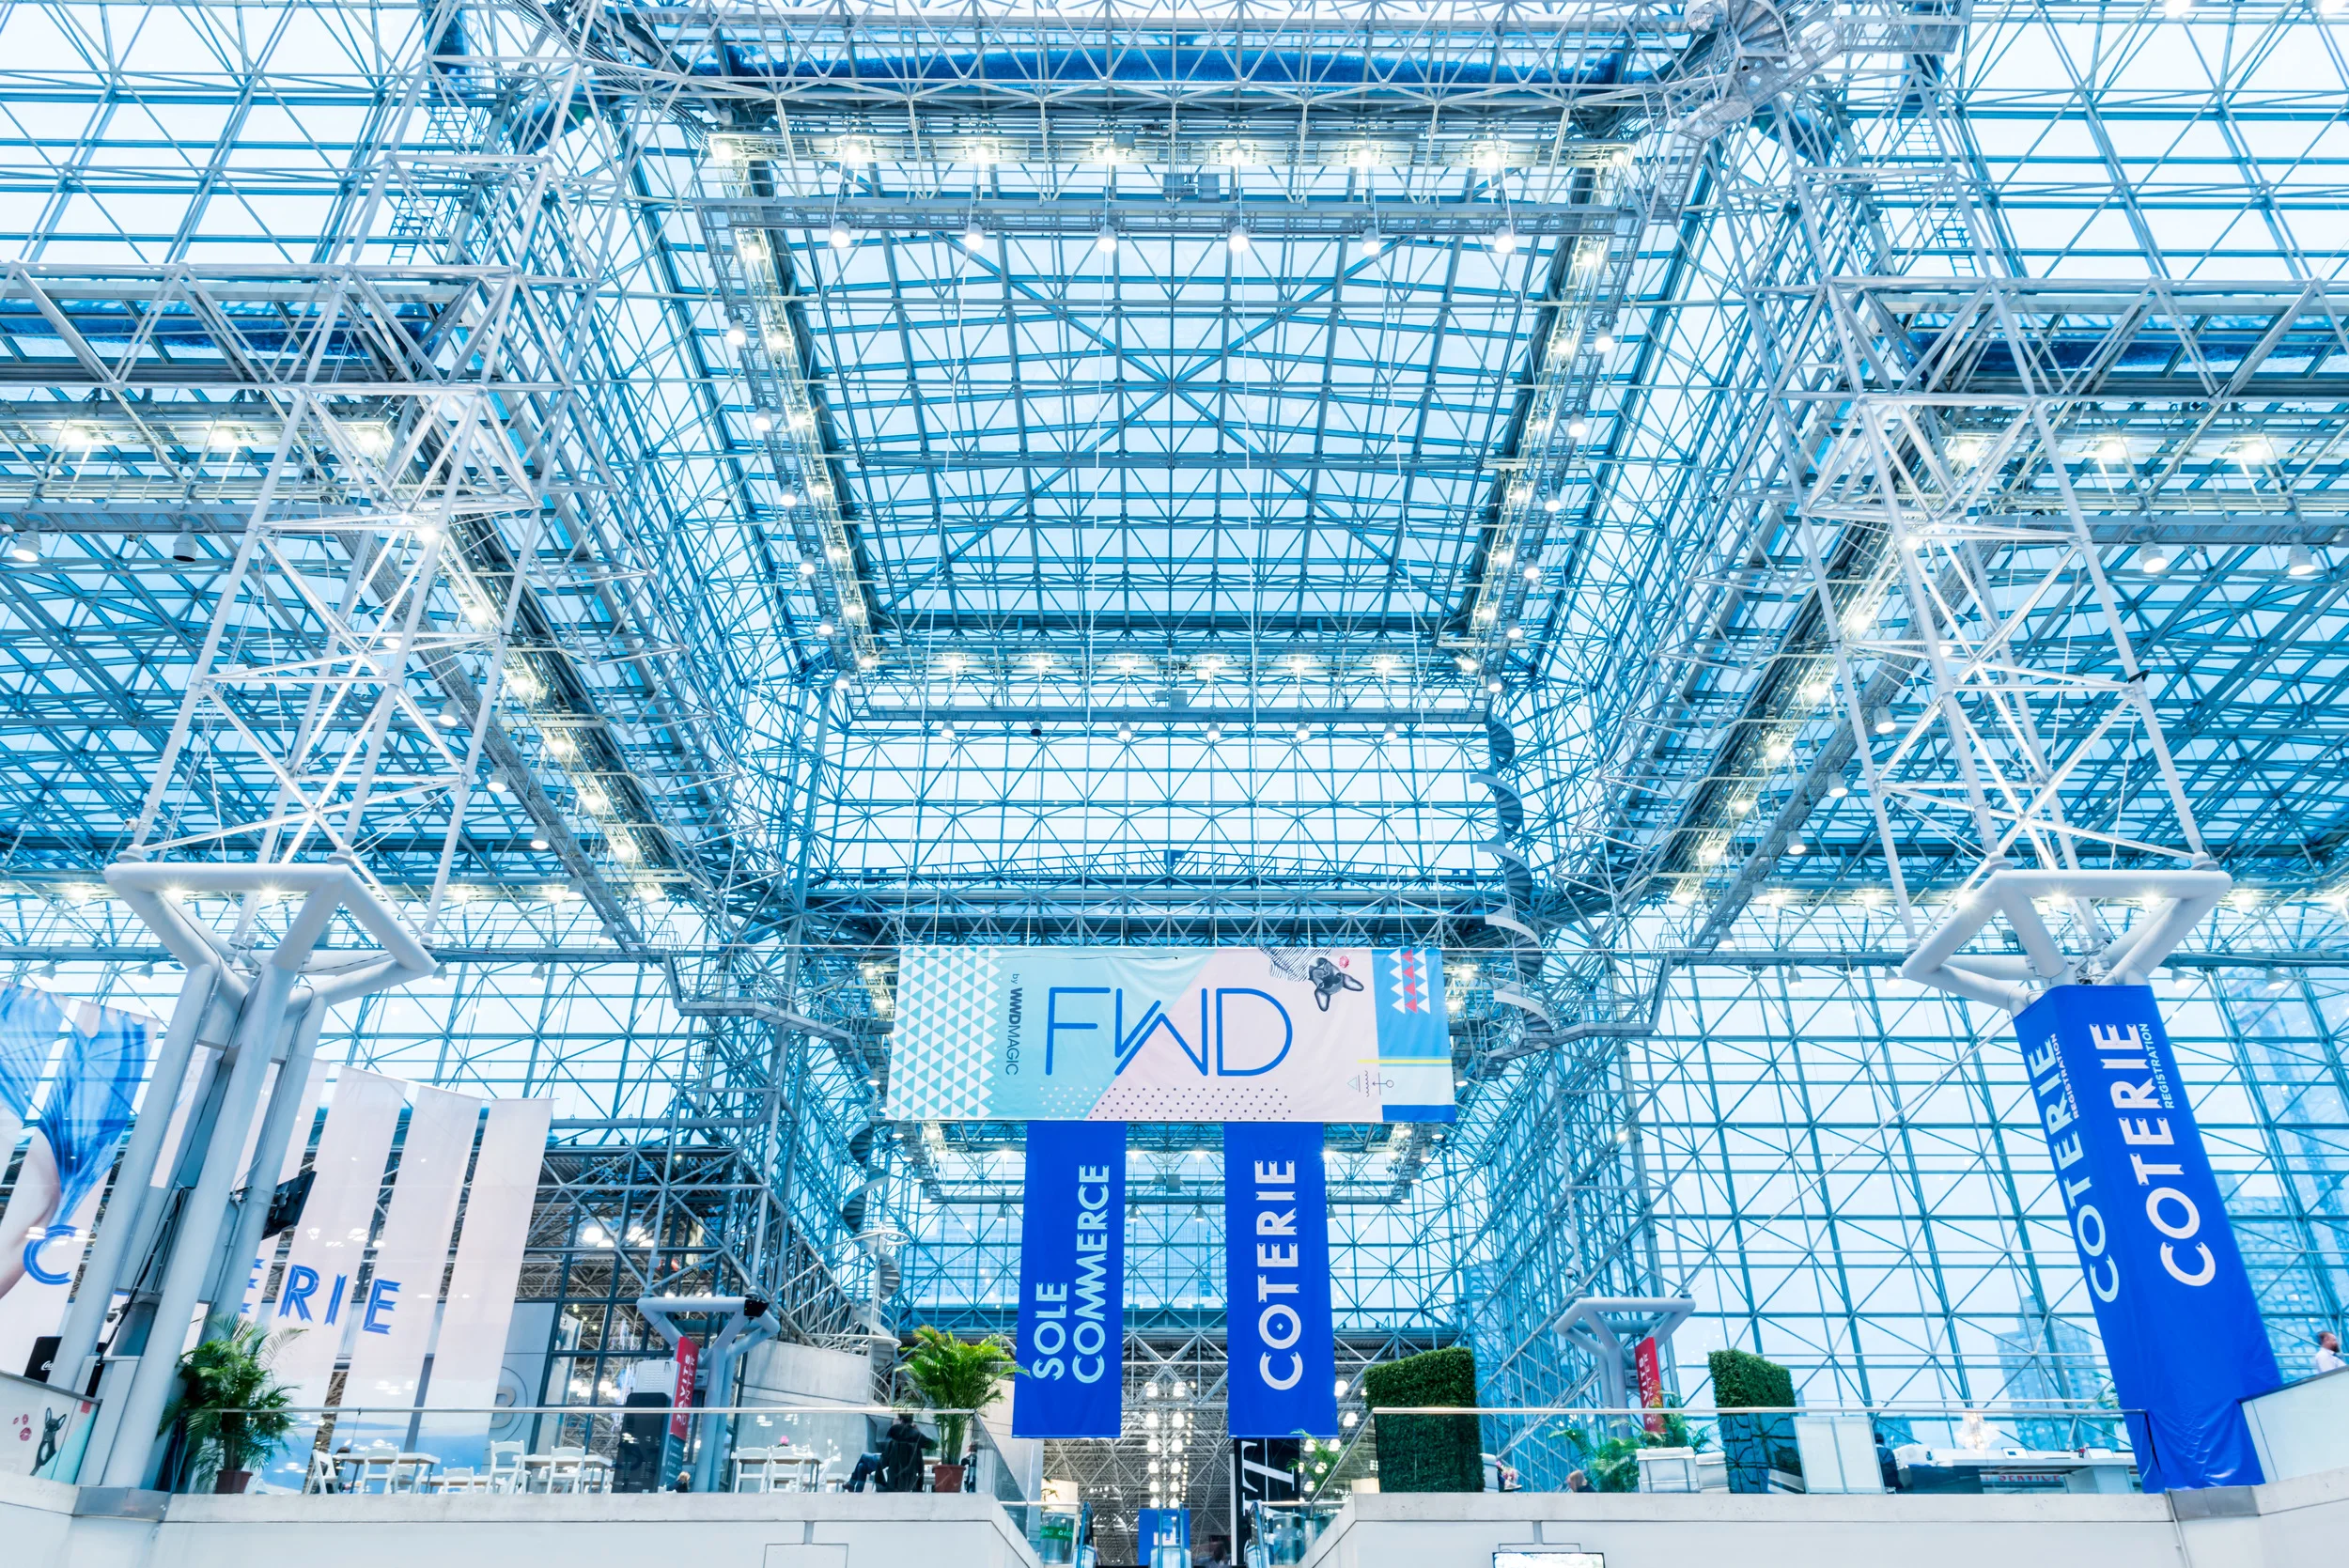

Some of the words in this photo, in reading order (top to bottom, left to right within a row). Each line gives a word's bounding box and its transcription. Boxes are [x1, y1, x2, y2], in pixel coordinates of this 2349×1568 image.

[1010, 973, 1020, 985] by
[1004, 986, 1023, 1076] WWDMAGIC
[1045, 986, 1293, 1077] FWD
[2049, 1032, 2080, 1120] REGISTRATION
[2138, 1023, 2175, 1110] REGISTRATION
[2028, 1037, 2120, 1303] COTERIE
[2089, 1023, 2217, 1287] COTERIE
[1071, 1165, 1110, 1384] COMMERCE
[1253, 1160, 1304, 1390] COTERIE
[1032, 1282, 1068, 1381] SOLE
